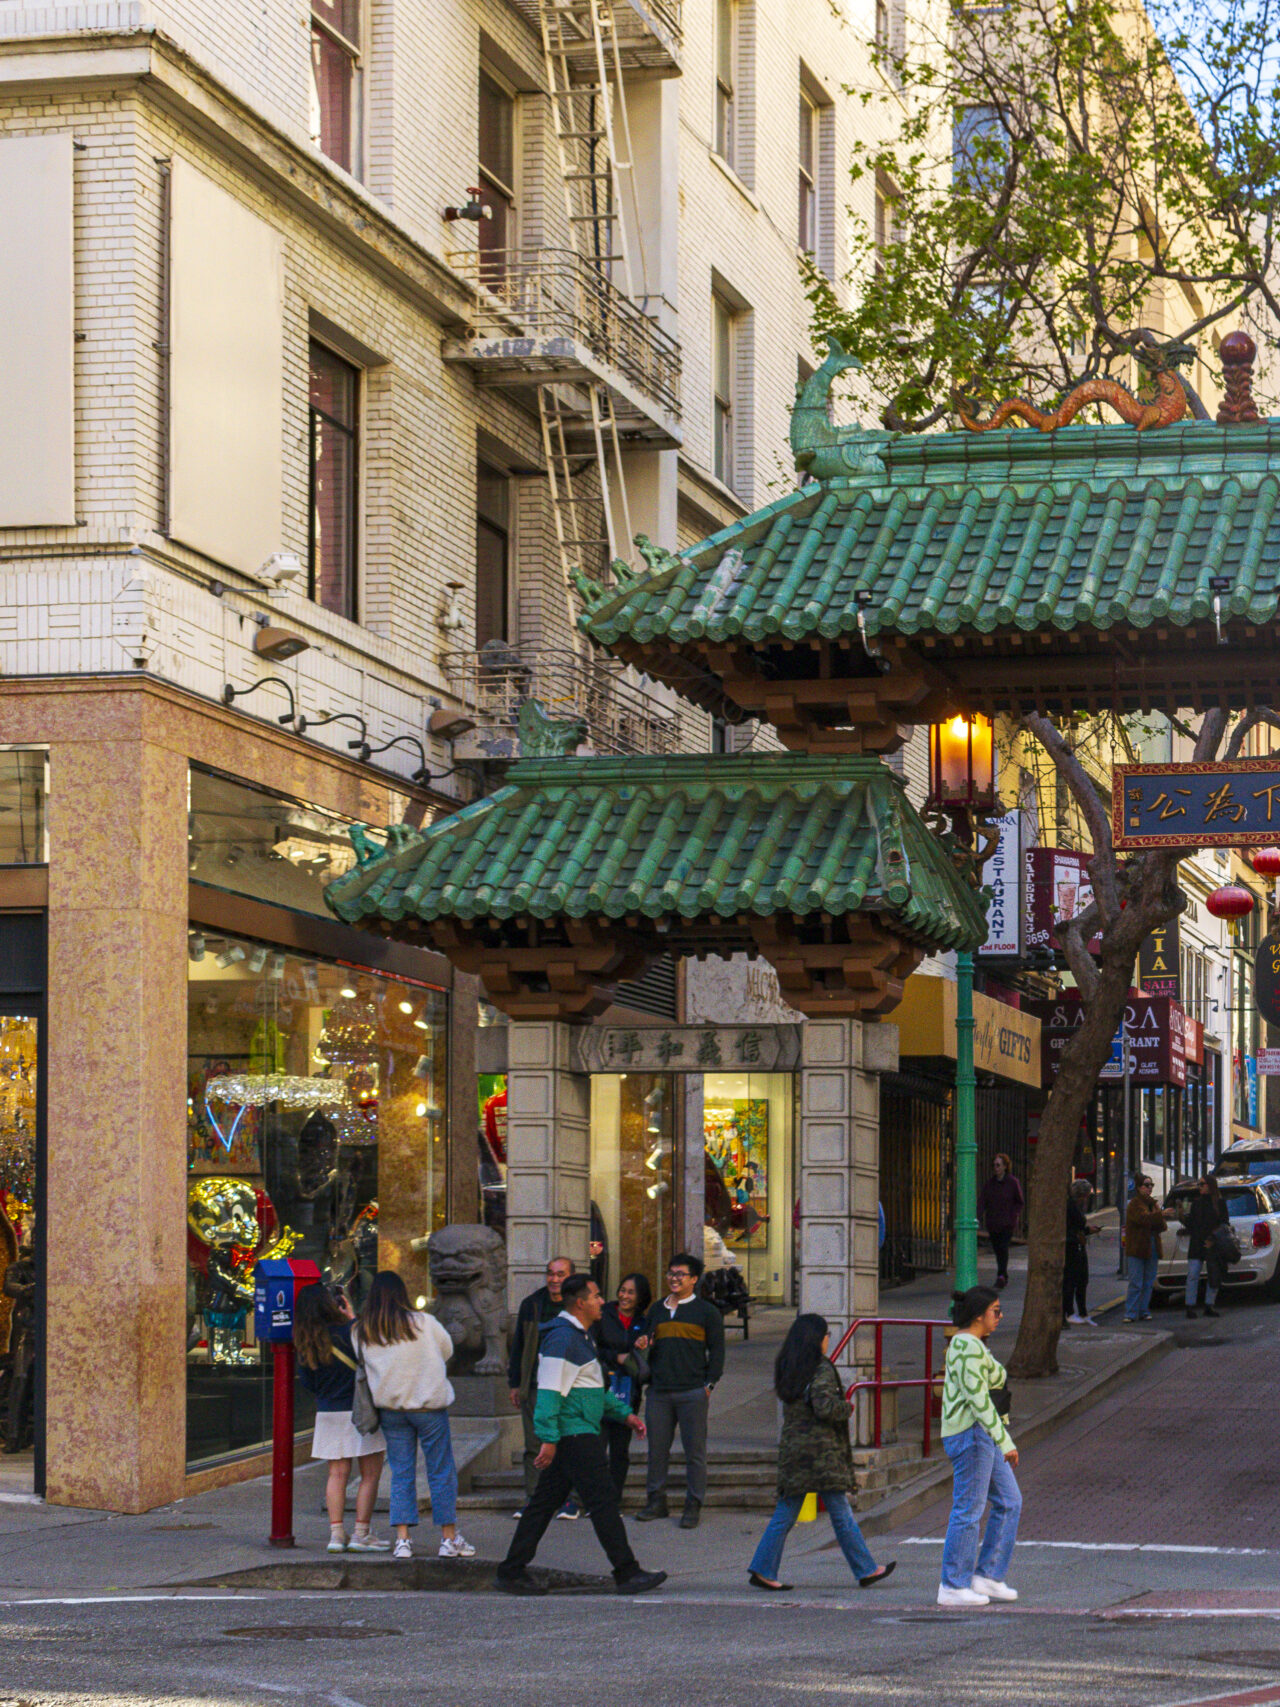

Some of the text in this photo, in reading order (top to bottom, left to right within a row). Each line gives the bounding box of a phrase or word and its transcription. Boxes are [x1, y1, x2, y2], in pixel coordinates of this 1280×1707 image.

[1054, 855, 1080, 867] SHAWARMA
[991, 836, 1005, 939] RESTAURANT
[1025, 853, 1036, 933] CATERING
[994, 943, 1016, 951] FLOOR
[1025, 929, 1050, 945] 3656
[1143, 980, 1177, 990] SALE
[1050, 1005, 1160, 1030] SARA
[1000, 1026, 1032, 1065] GIFTS
